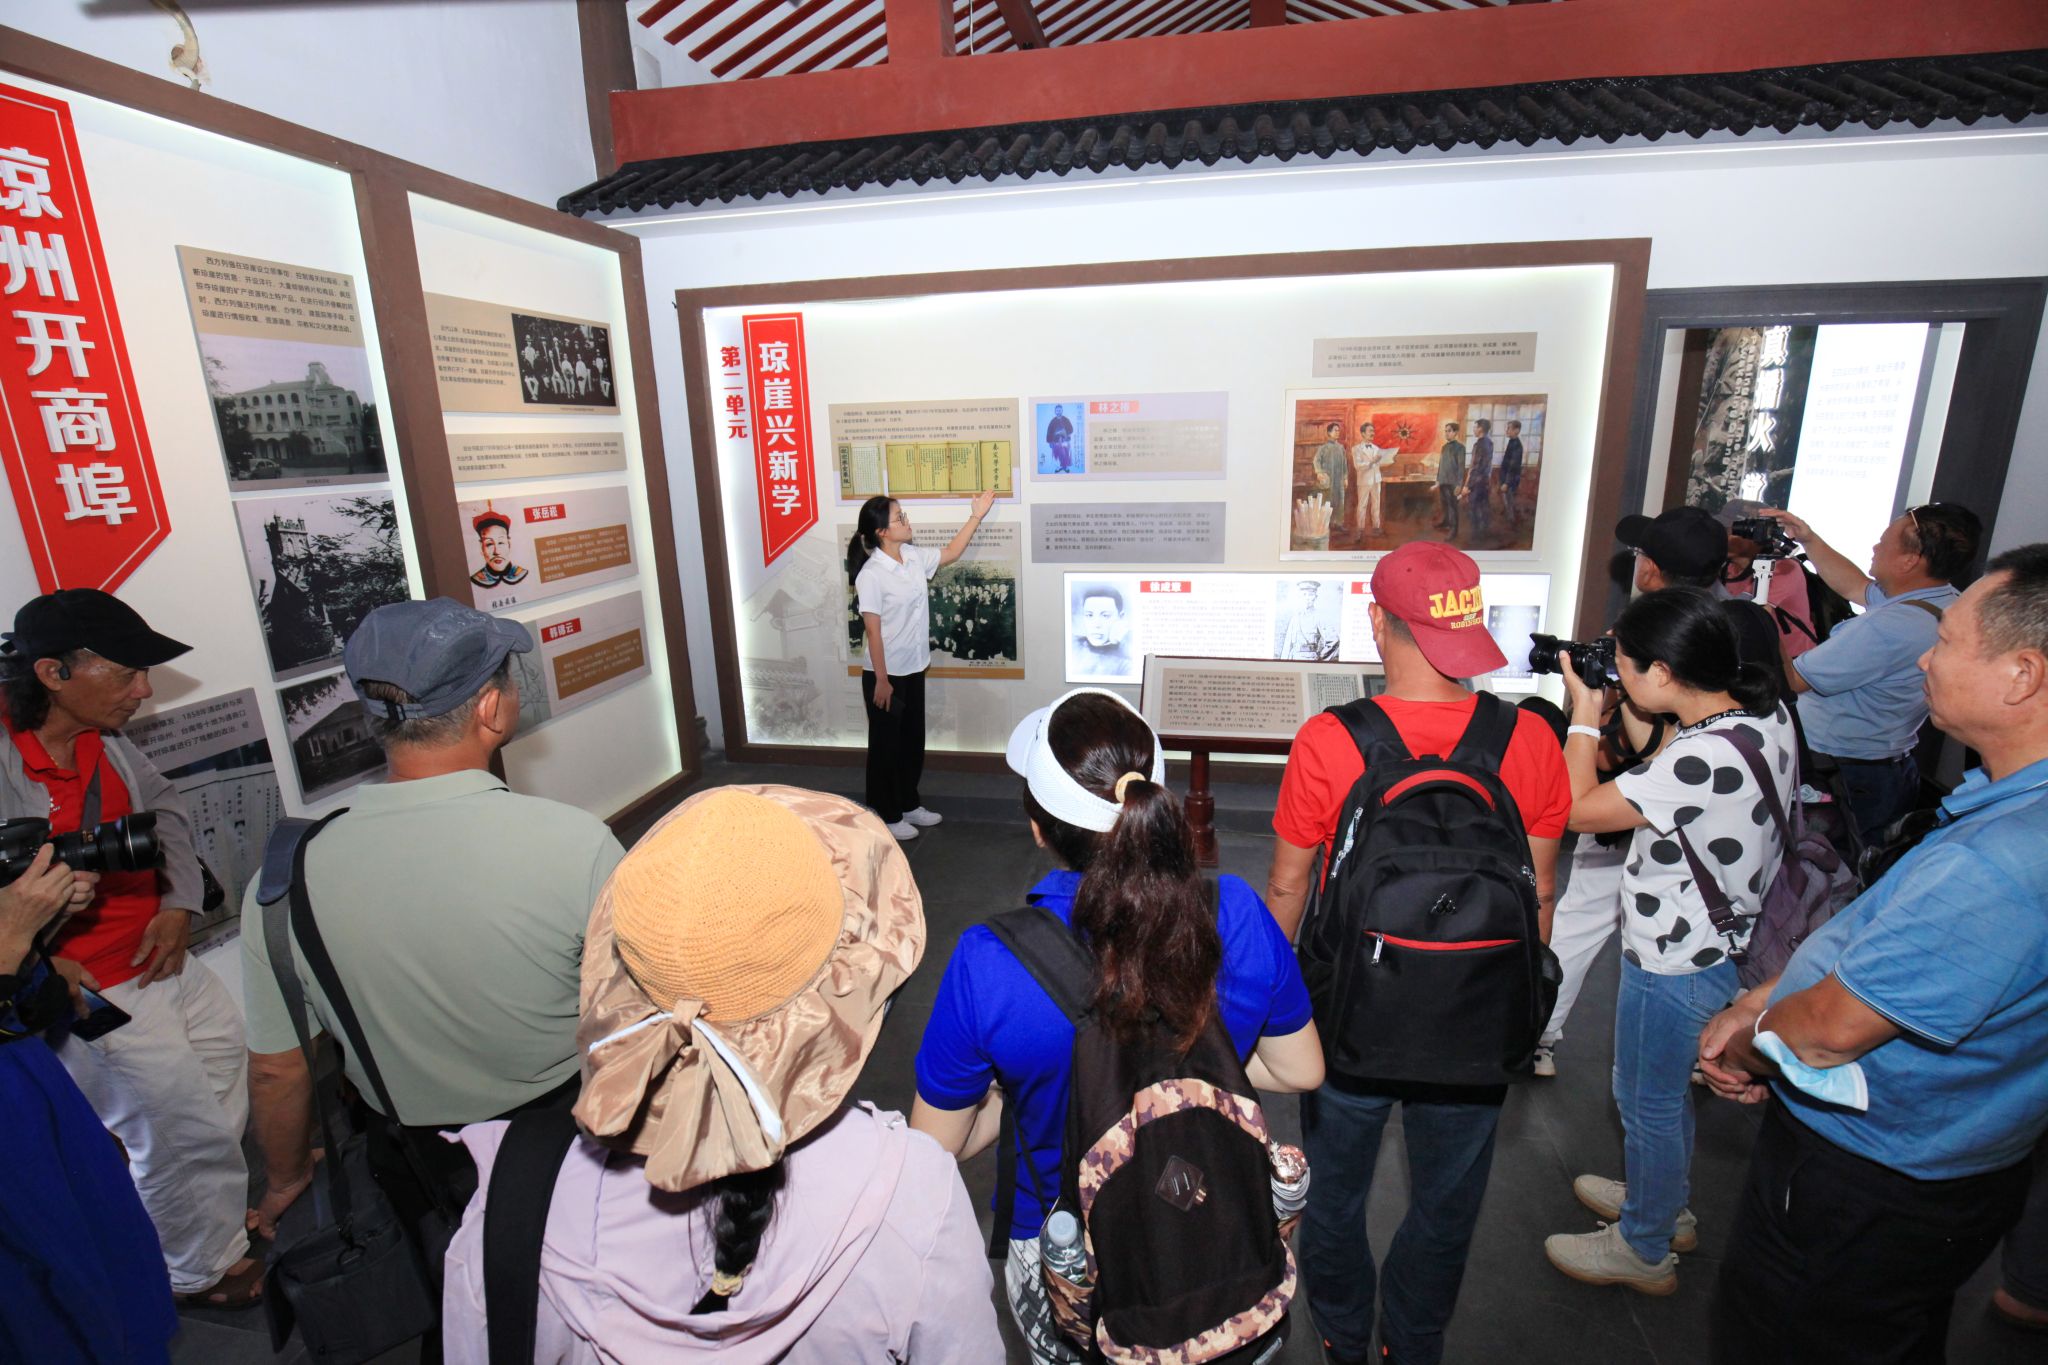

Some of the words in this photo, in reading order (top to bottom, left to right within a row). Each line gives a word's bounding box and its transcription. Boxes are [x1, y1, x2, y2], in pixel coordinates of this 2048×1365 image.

[0, 146, 138, 525] 琼州开商埠
[720, 346, 748, 439] 第二单元
[758, 341, 801, 516] 琼崖兴新学
